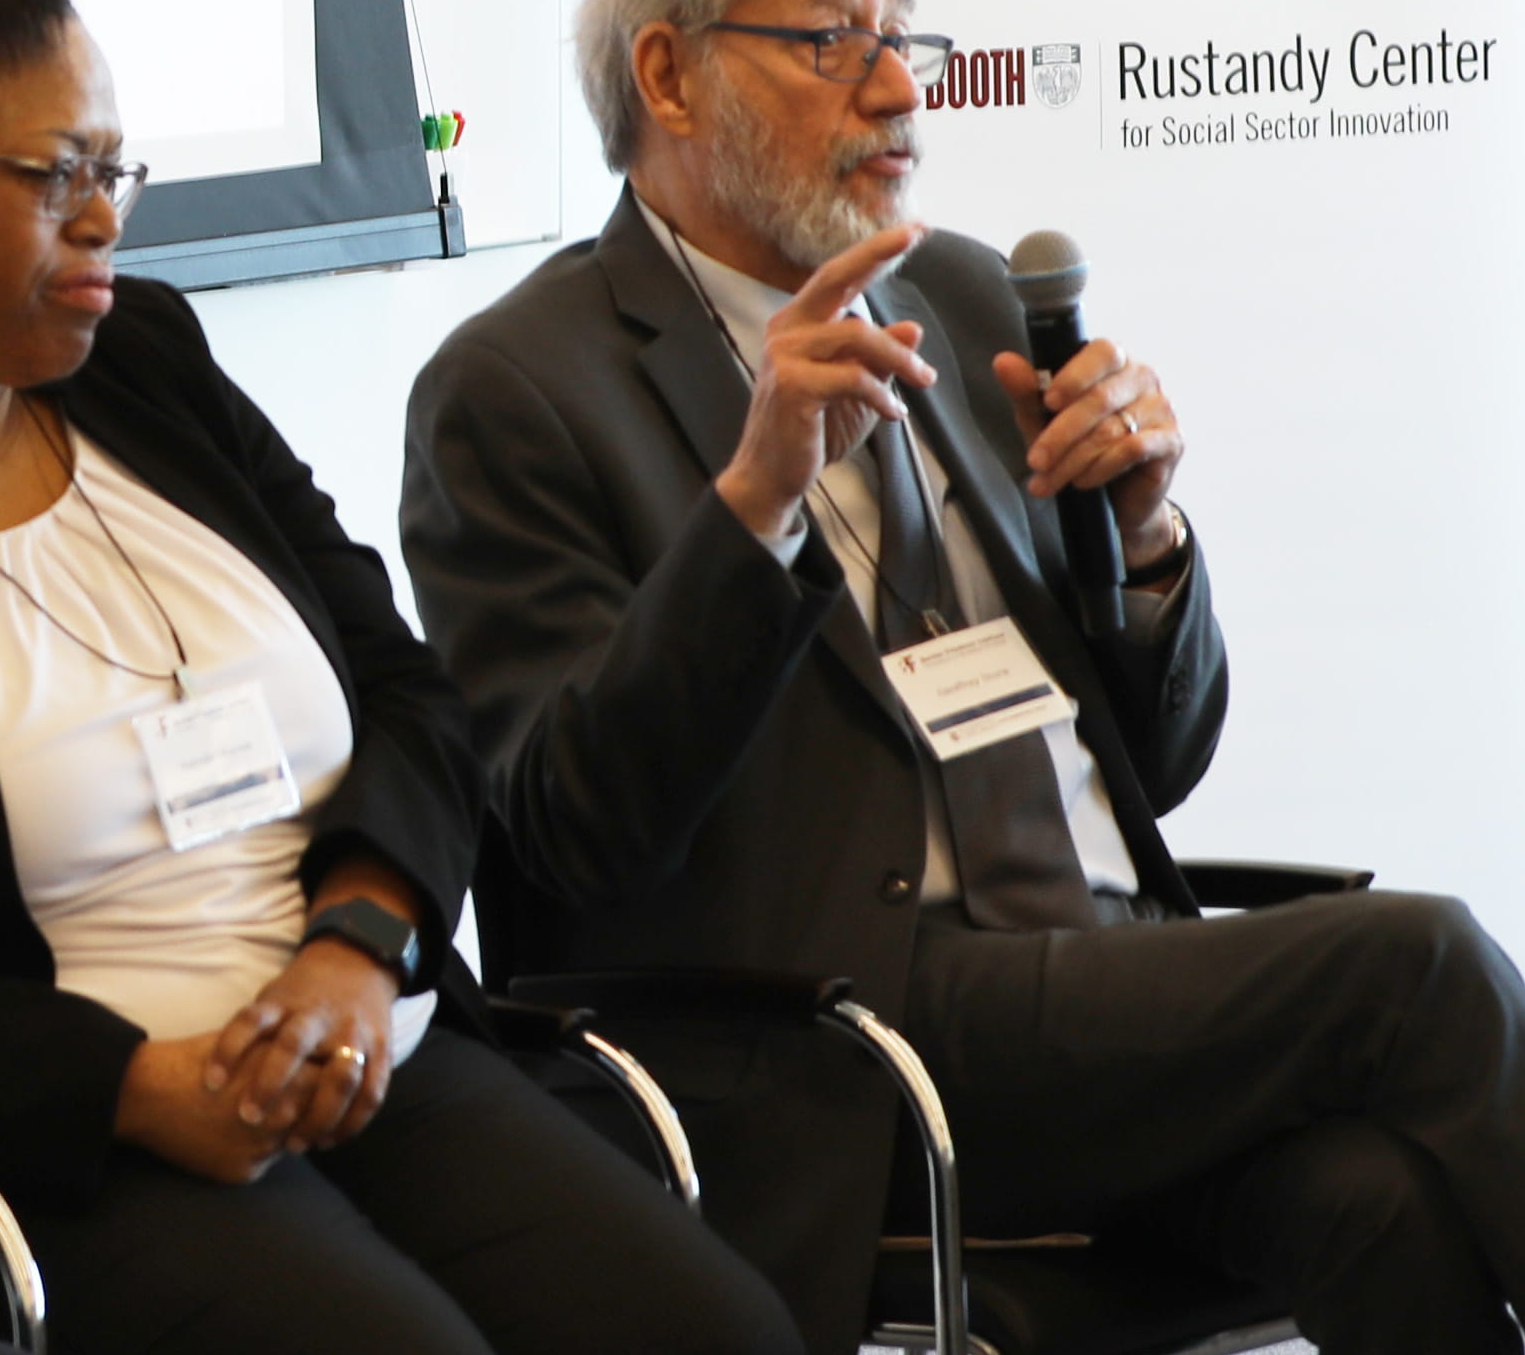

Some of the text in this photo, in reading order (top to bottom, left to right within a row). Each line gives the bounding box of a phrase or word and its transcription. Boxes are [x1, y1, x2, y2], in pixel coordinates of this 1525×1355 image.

[1118, 28, 1497, 105] Rustandy Center
[1120, 105, 1449, 149] for Social Sector Innovation
